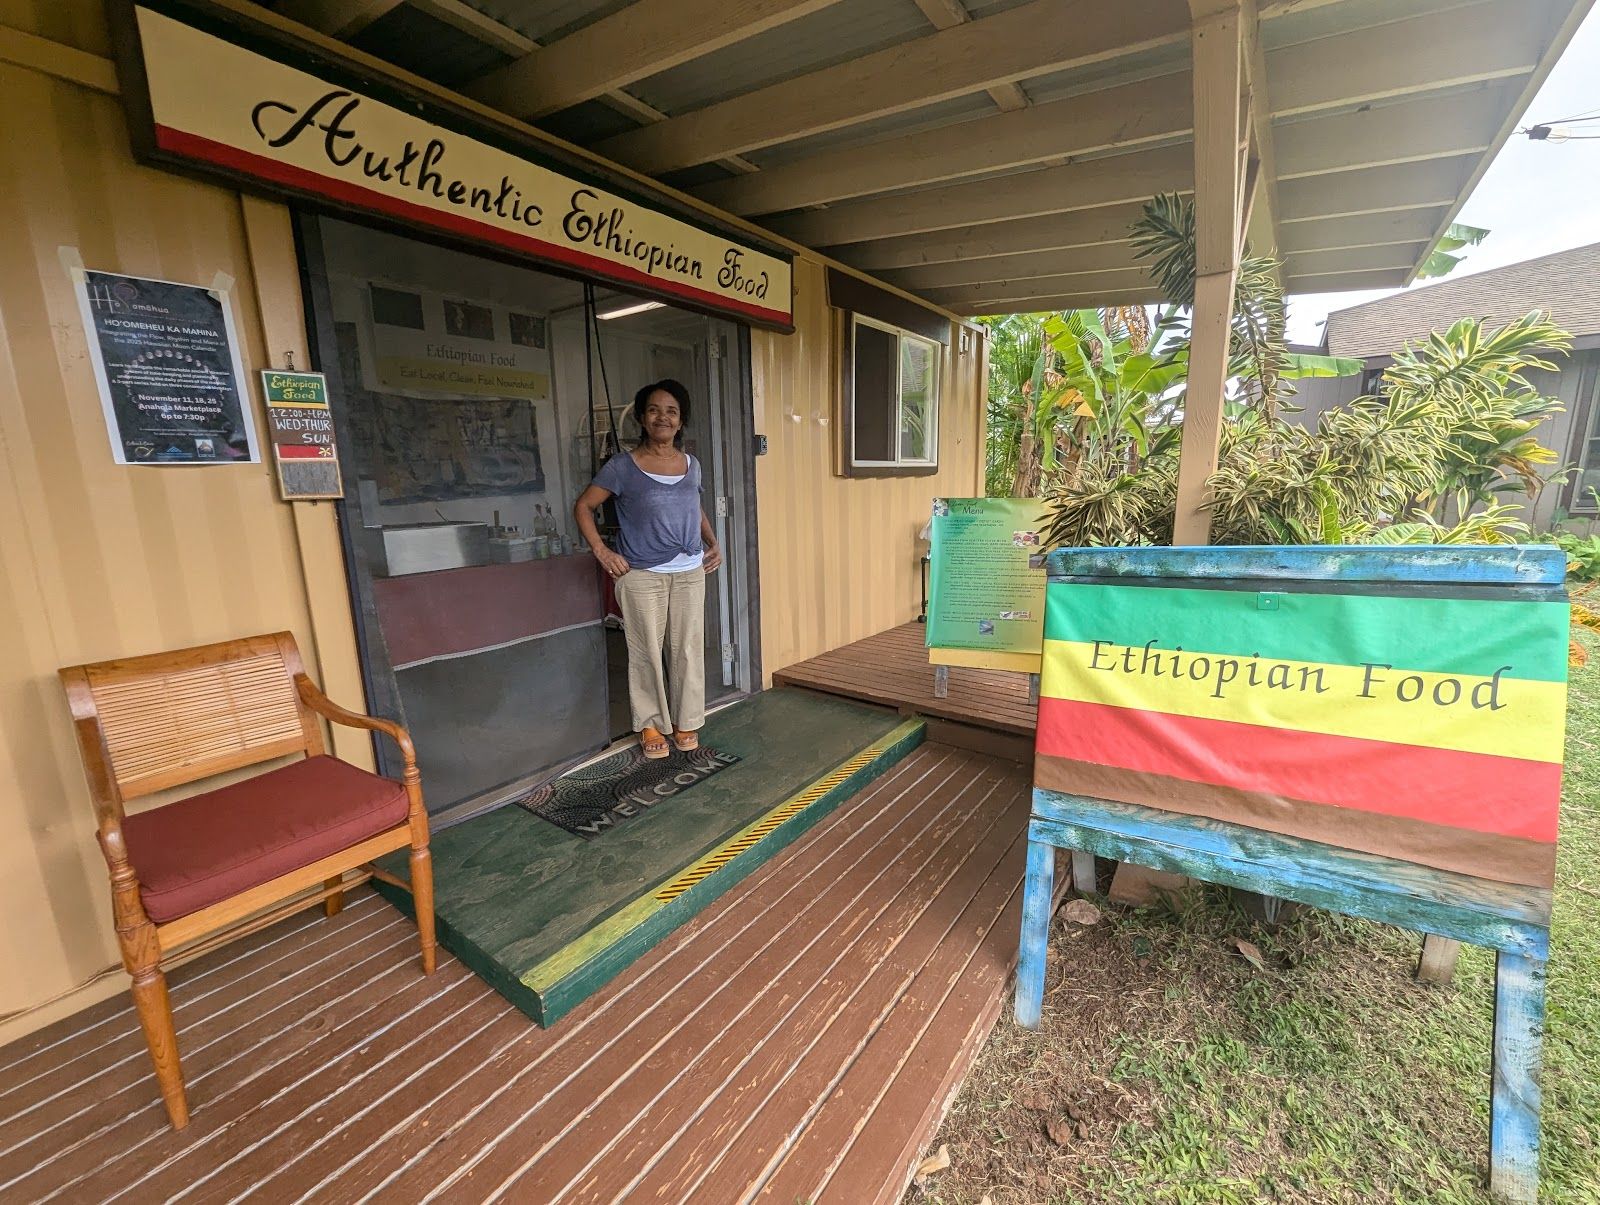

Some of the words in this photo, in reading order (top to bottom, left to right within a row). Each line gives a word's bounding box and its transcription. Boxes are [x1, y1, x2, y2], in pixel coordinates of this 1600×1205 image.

[252, 90, 543, 226] Authentic
[562, 189, 703, 279] Ethiopian
[718, 248, 769, 300] Food
[167, 325, 180, 334] KA
[182, 326, 219, 338] MAHINA
[426, 343, 486, 366] Ethiopian
[490, 352, 516, 368] Food
[271, 375, 321, 390] Ethiopian
[400, 366, 417, 377] Eat
[497, 376, 535, 389] Nourished
[138, 394, 180, 403] November
[283, 388, 316, 400] Food
[174, 404, 222, 413] Marketplace
[184, 413, 205, 421] 7:30p
[1088, 639, 1331, 698] Ethiopian
[1356, 662, 1513, 711] Food
[577, 752, 738, 835] WELCOME
